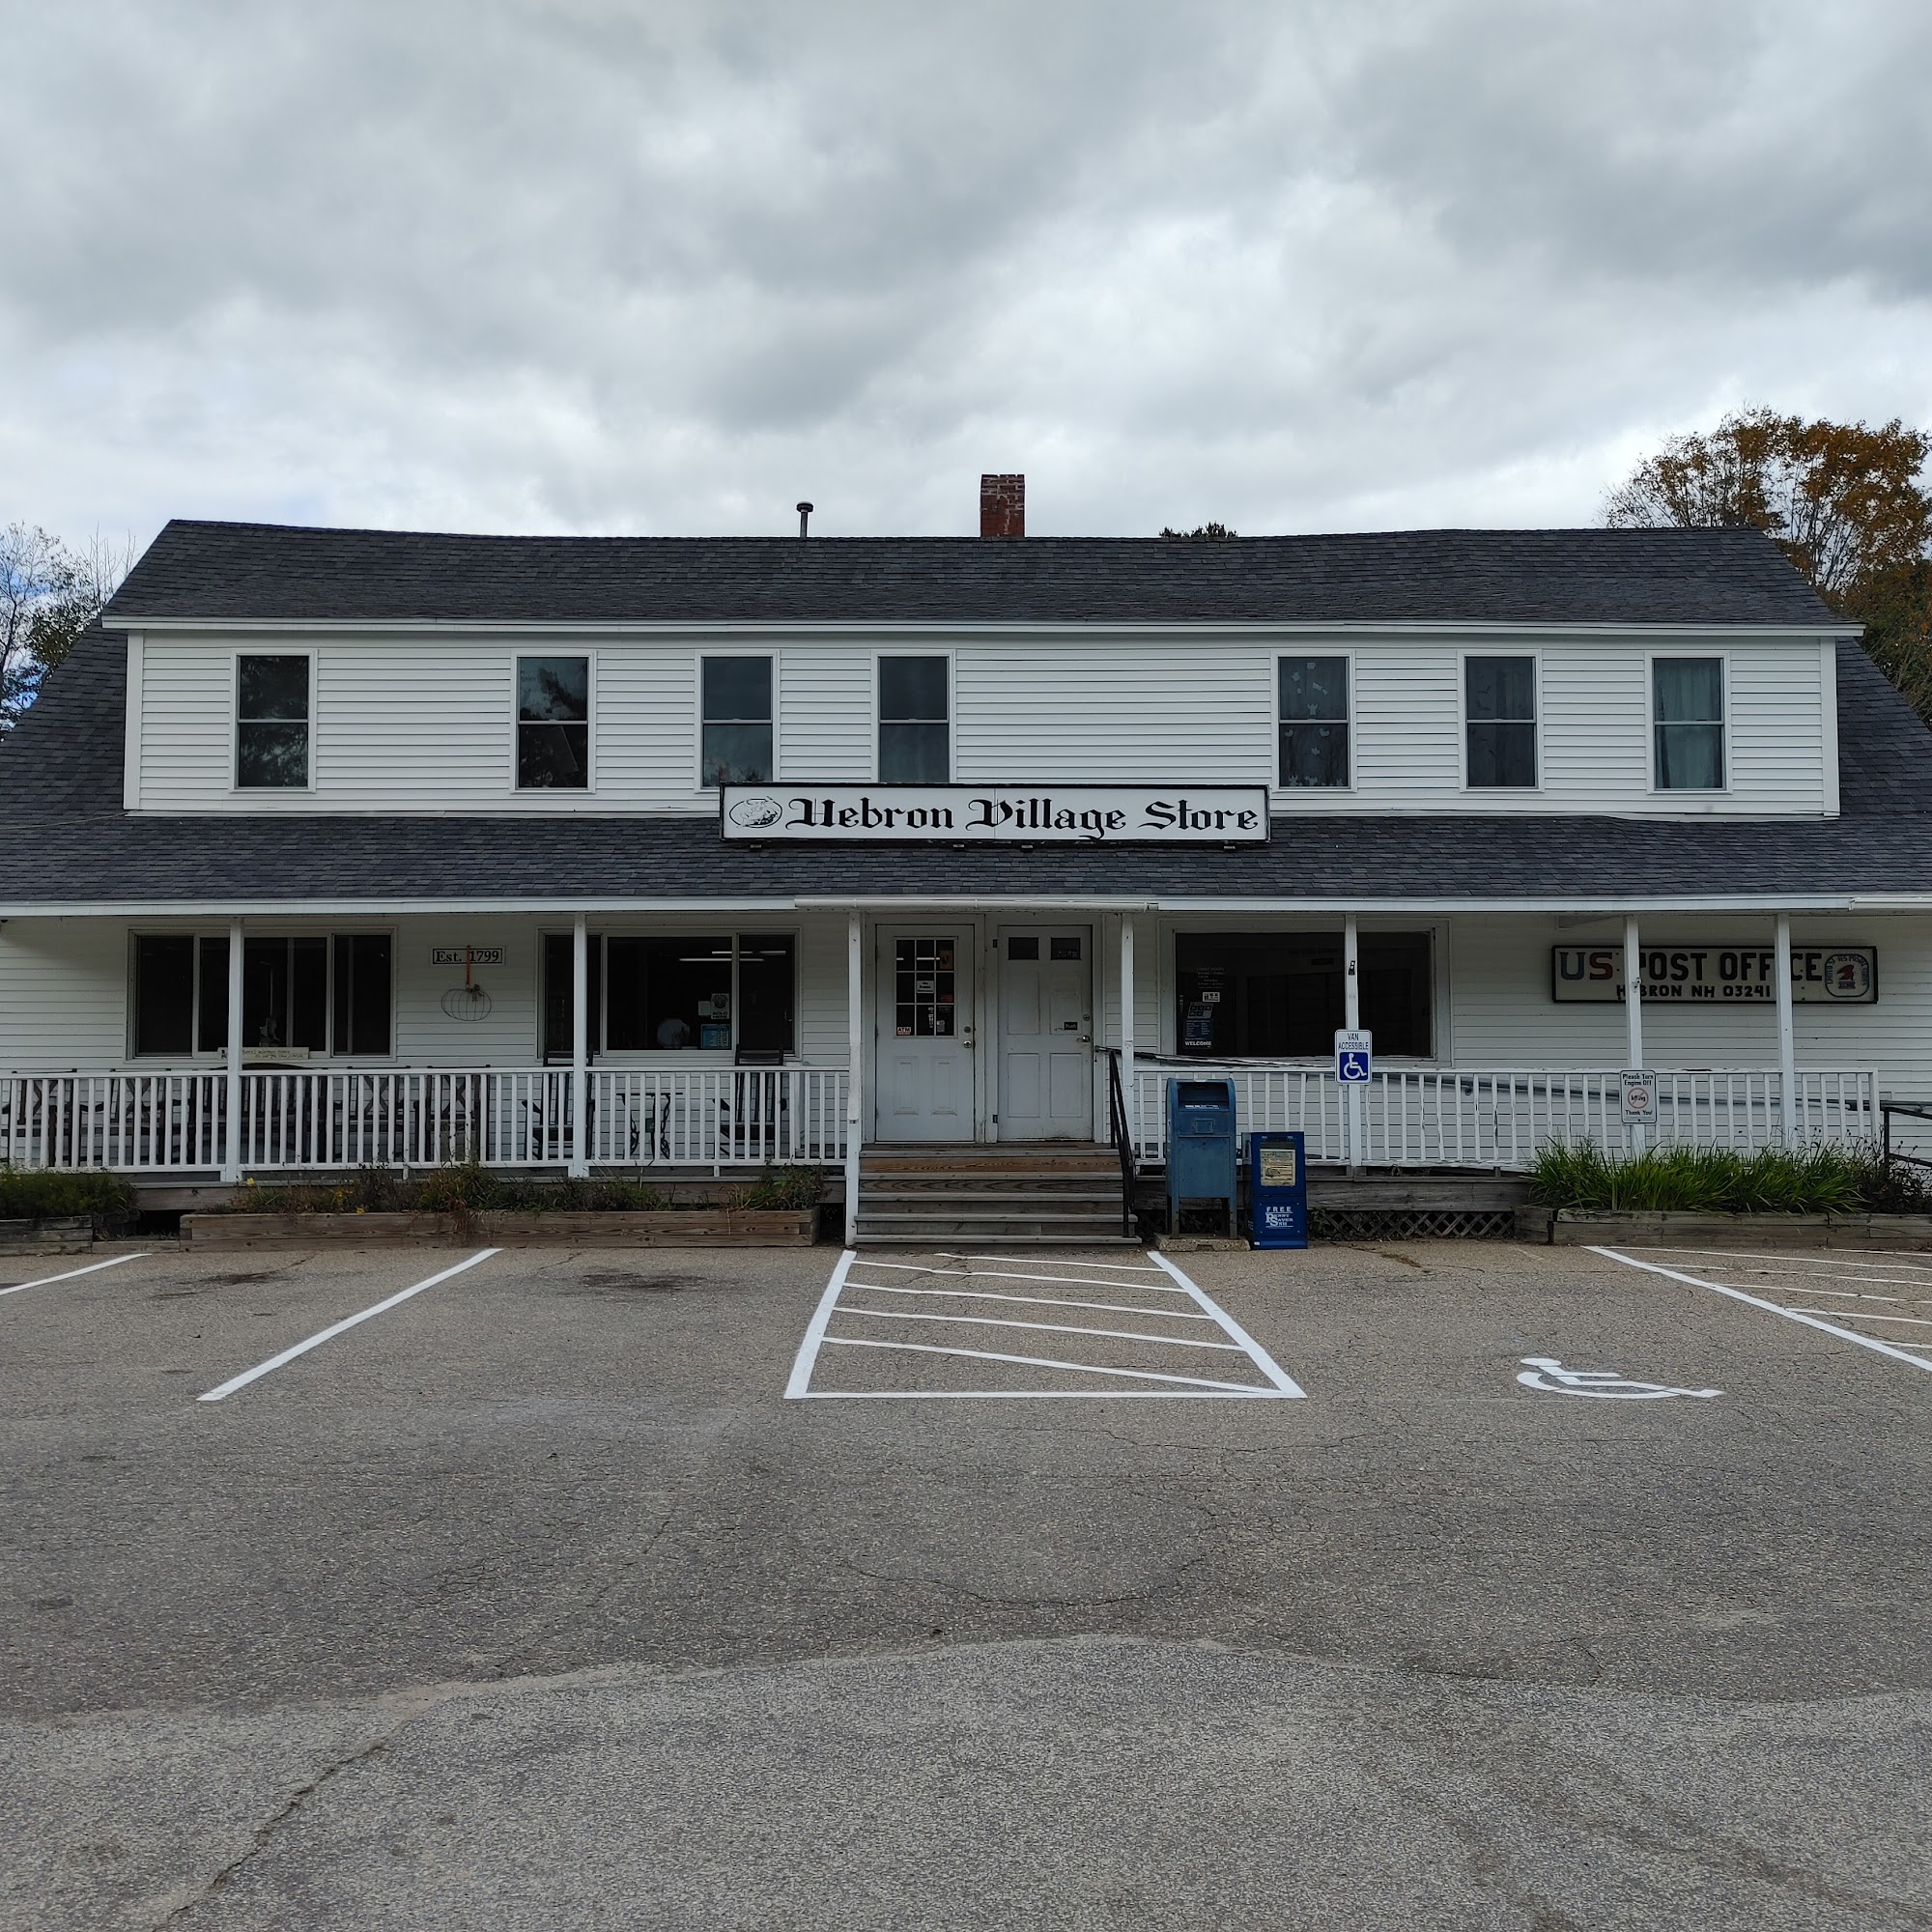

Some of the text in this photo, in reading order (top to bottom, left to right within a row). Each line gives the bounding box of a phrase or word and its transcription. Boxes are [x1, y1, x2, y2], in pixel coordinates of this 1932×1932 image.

[785, 797, 1259, 839] Hebron Village Store
[436, 951, 499, 962] Est. 1799
[1559, 952, 1613, 980] US
[1720, 952, 1823, 980] OFFCE
[1617, 984, 1771, 998] HBRON NH 03241
[1347, 1033, 1359, 1041] VAN
[1338, 1041, 1369, 1050] ACCESSIBLE
